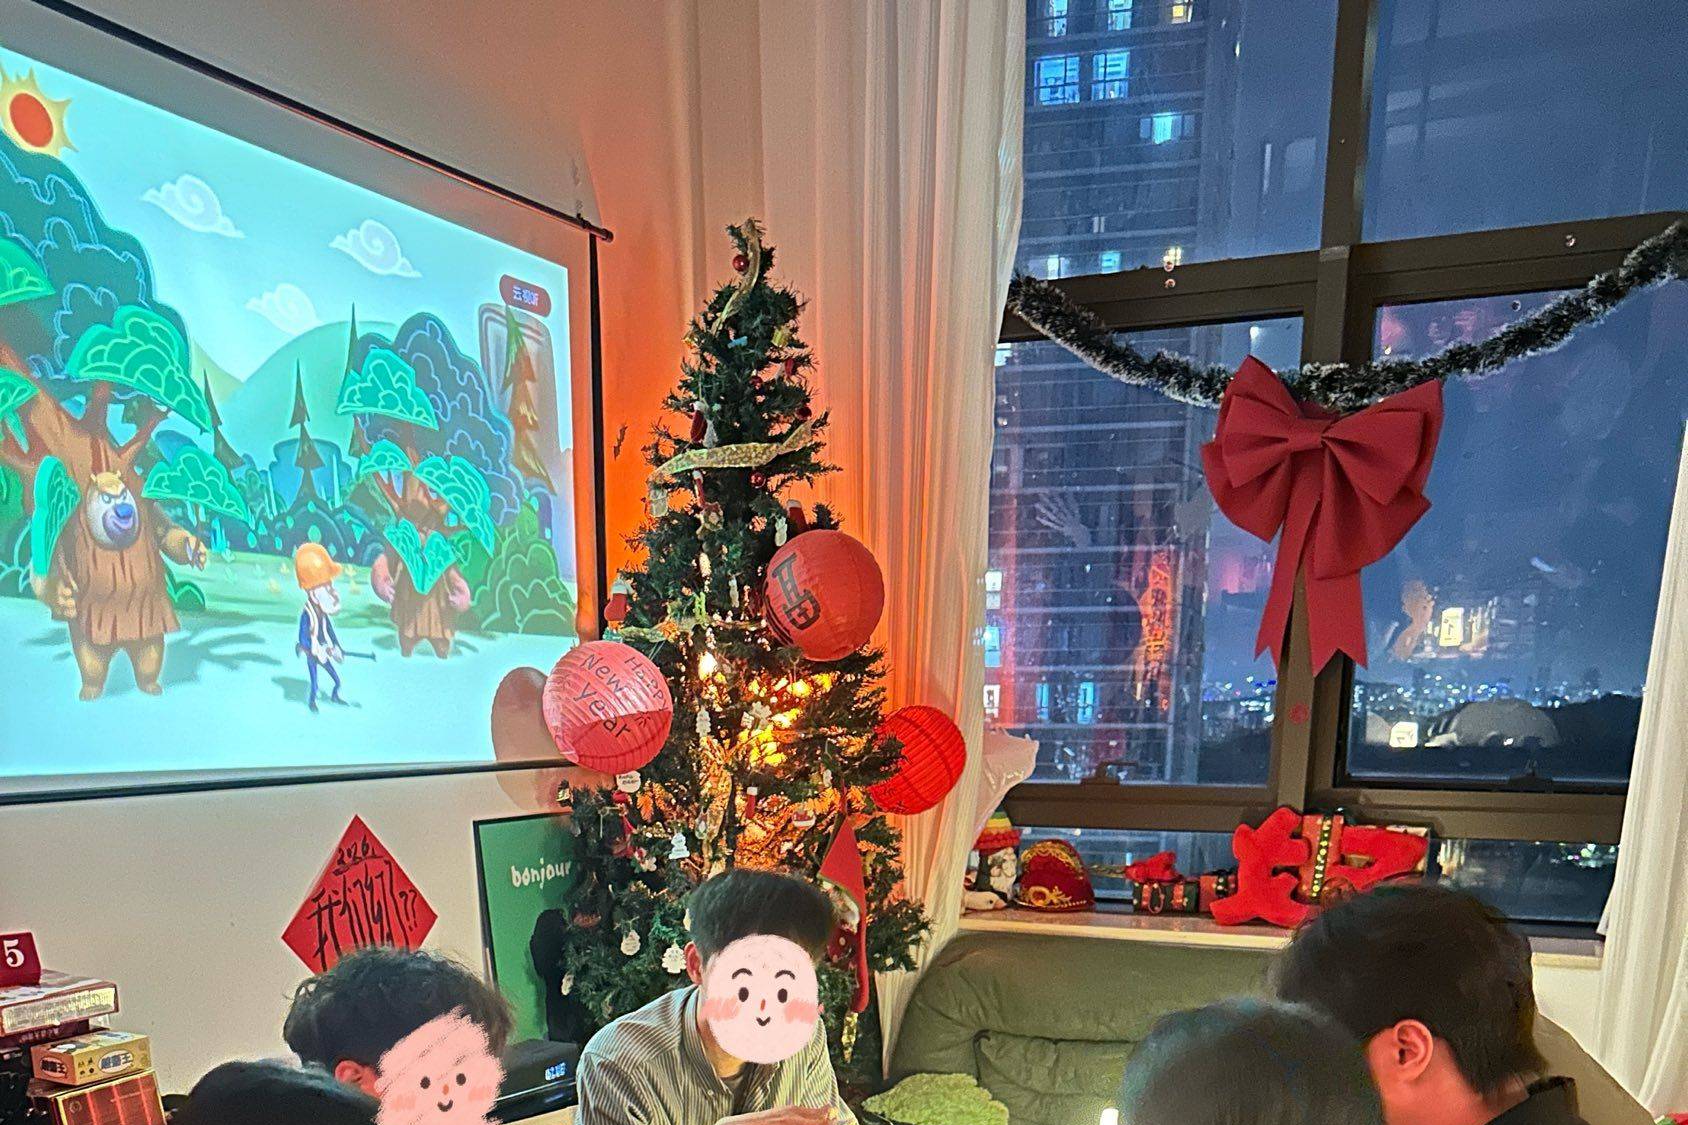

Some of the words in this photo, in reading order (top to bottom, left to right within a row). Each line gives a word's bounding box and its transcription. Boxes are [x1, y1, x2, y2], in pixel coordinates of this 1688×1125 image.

[580, 653, 625, 693] New
[510, 857, 572, 890] bonjour
[3, 938, 25, 968] 5
